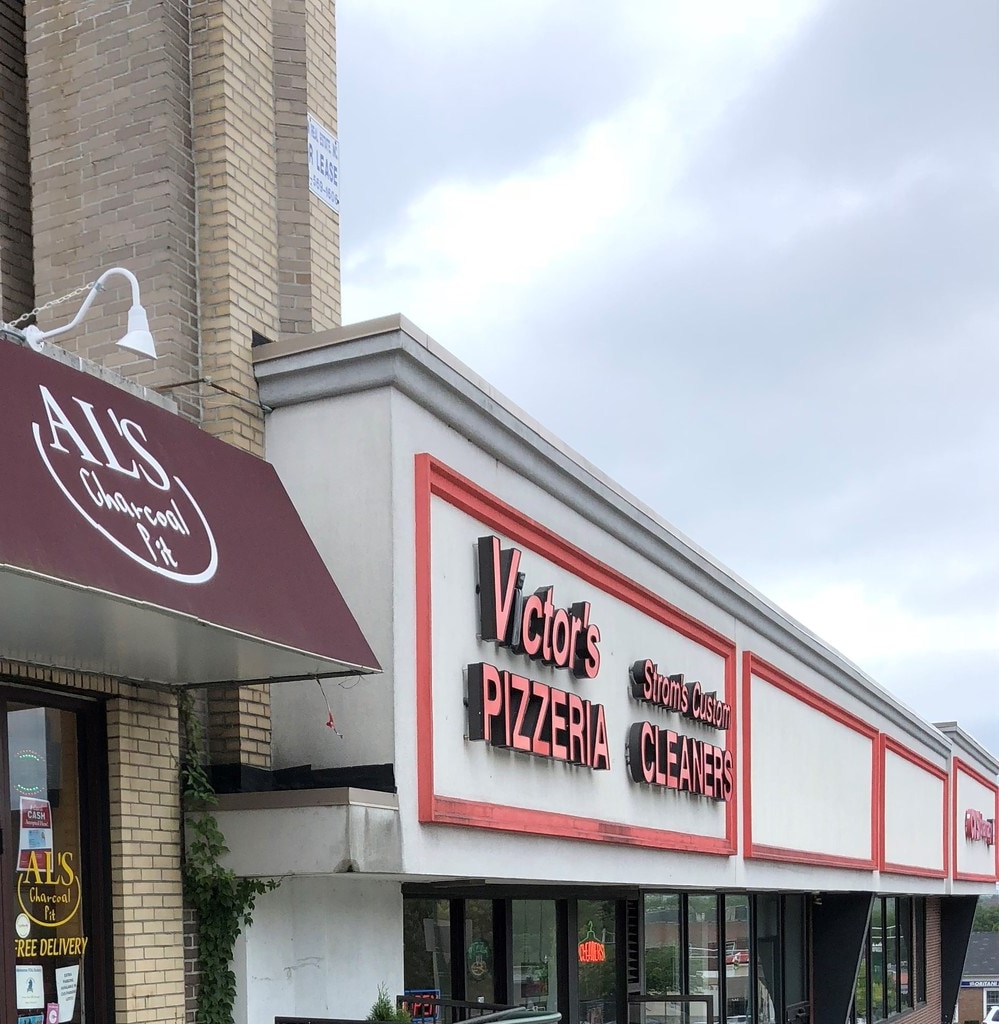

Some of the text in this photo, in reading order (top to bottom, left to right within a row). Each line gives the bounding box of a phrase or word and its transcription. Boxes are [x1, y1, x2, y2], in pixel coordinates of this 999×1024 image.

[316, 149, 338, 187] LEASE
[39, 384, 171, 491] AL'S
[79, 467, 190, 535] Charcoal
[136, 522, 178, 568] Pit
[482, 535, 601, 679] Victor's
[473, 662, 611, 770] PIZZERIA
[638, 659, 732, 730] Strom's Custom
[635, 720, 734, 801] CLEANERS
[27, 810, 46, 821] CASH
[23, 850, 74, 886] AL'S
[29, 887, 71, 904] Charcoal
[44, 904, 56, 922] Pit
[40, 936, 89, 957] DELIVERY
